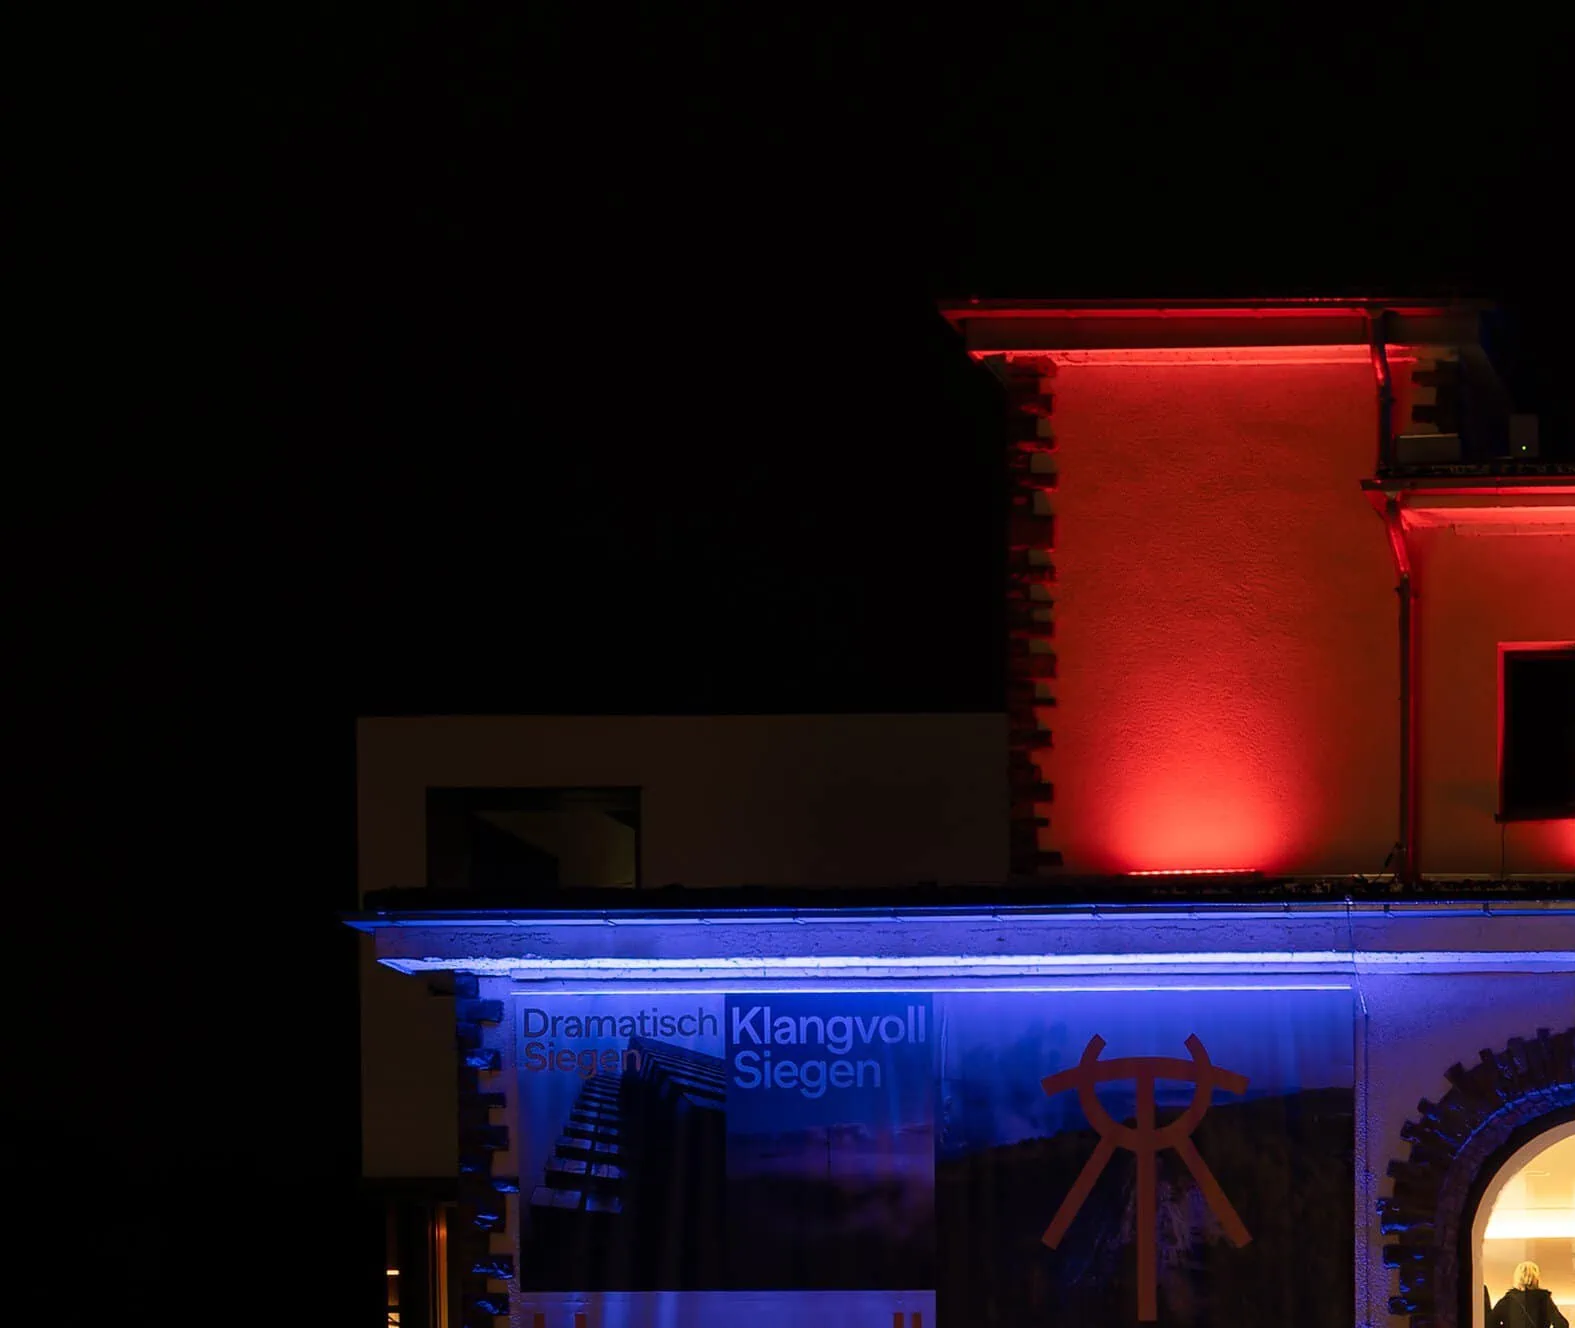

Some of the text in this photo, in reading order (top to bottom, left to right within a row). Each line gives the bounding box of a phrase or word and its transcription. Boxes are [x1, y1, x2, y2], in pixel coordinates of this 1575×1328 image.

[523, 1007, 718, 1038] Dramatisch
[731, 1006, 926, 1055] Klangvoll
[524, 1042, 641, 1079] Siegen
[733, 1050, 881, 1099] Siegen
